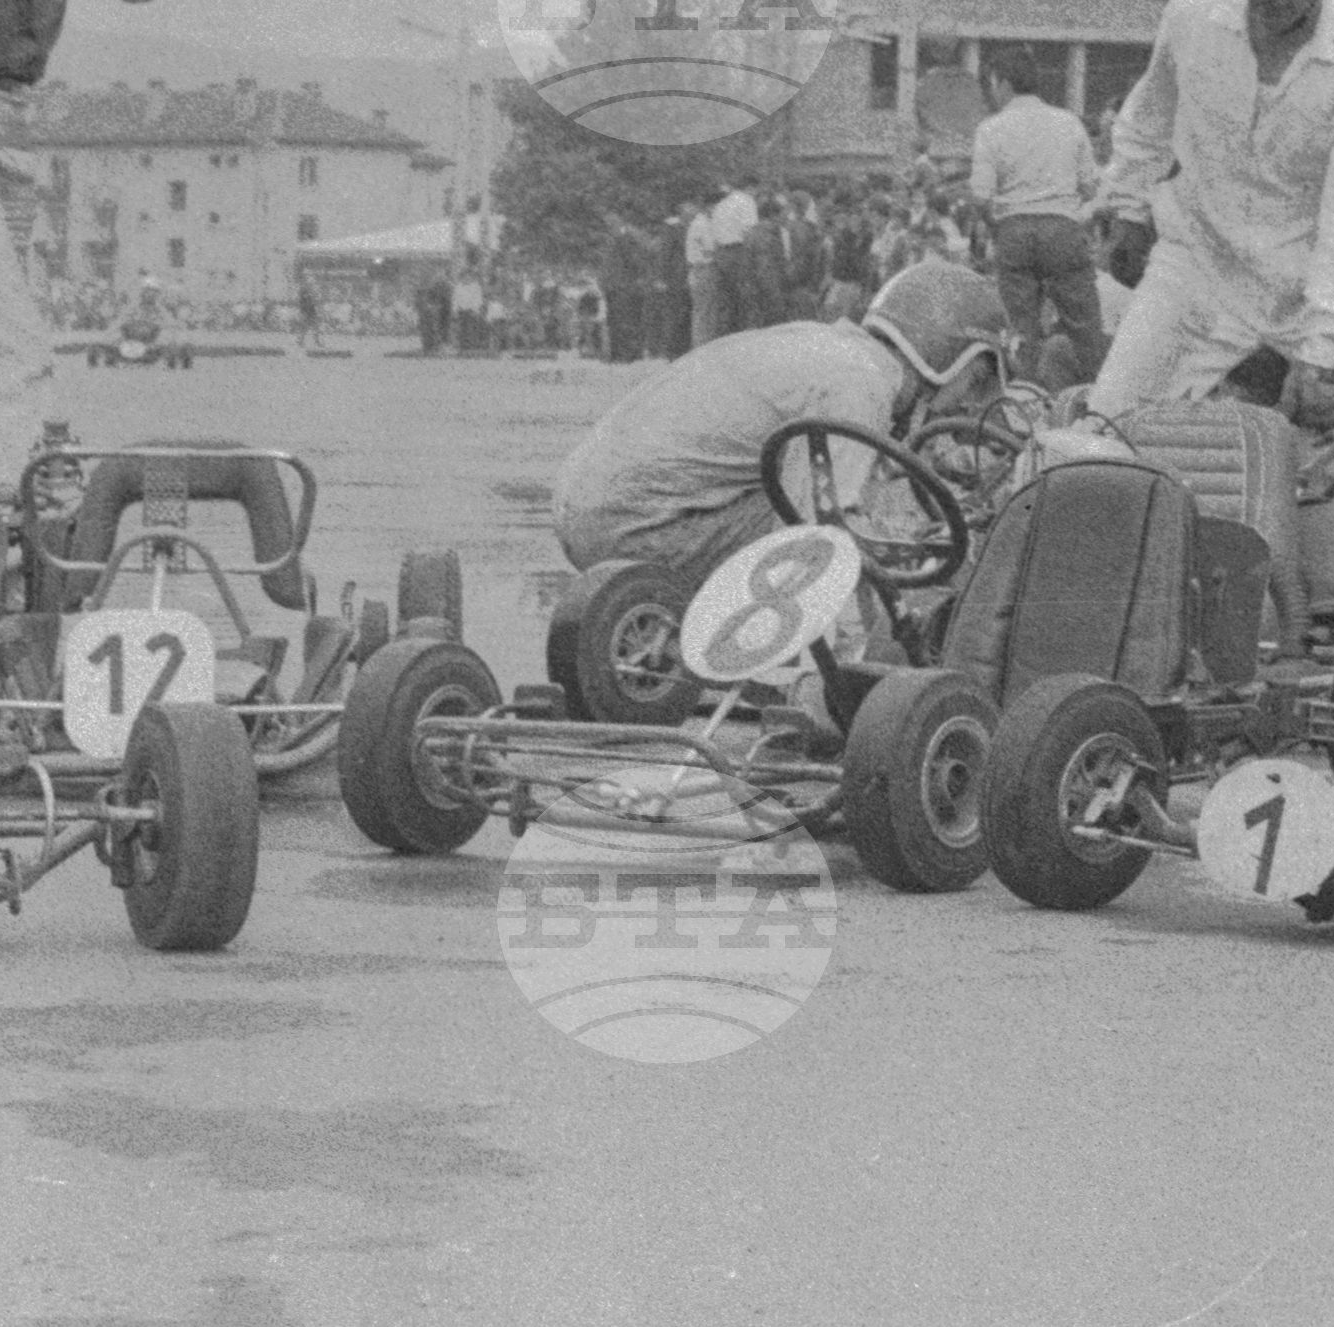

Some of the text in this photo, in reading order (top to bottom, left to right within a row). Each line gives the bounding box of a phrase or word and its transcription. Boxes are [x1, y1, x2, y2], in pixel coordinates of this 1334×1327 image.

[701, 538, 837, 672] 8
[87, 633, 187, 714] 12
[1243, 793, 1286, 896] 1
